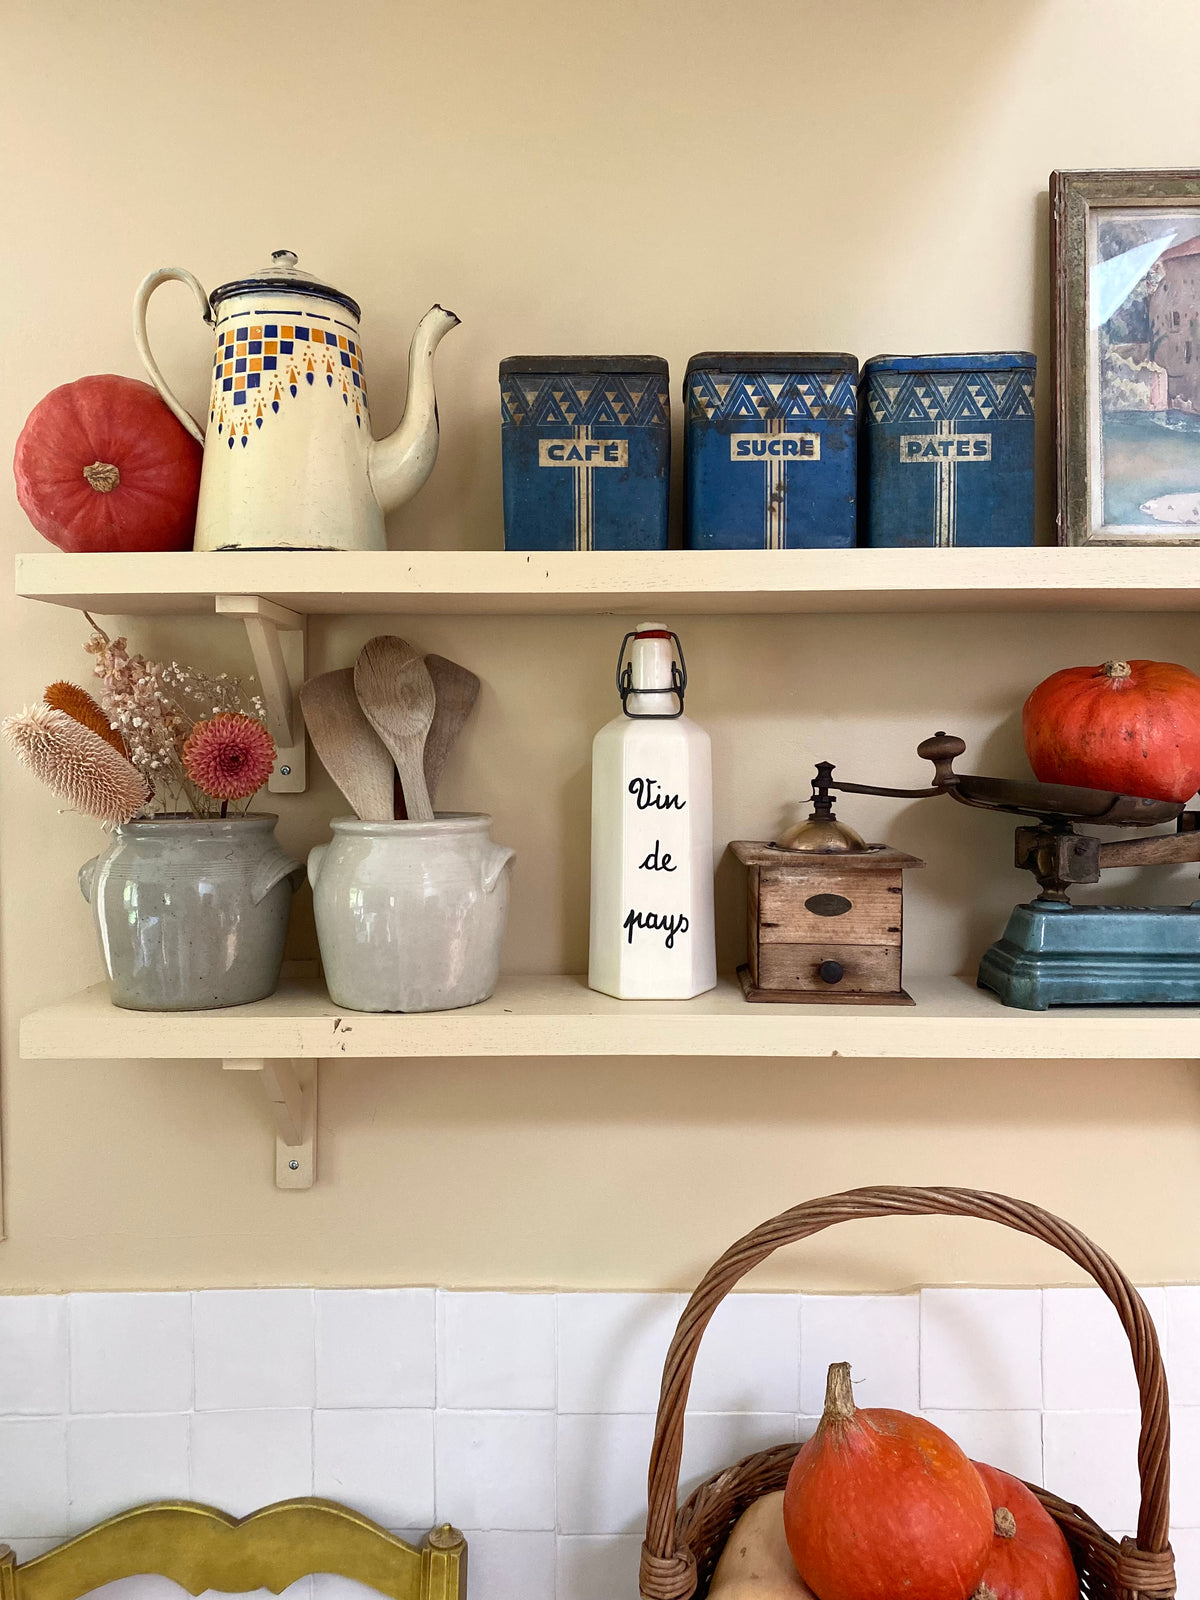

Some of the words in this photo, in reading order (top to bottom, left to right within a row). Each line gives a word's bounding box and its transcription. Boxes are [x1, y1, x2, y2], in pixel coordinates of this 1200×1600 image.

[547, 441, 619, 462] CAFÉ
[736, 439, 814, 457] SUCRE
[628, 777, 687, 810] Vin
[638, 839, 678, 872] de
[623, 909, 689, 949] pays
